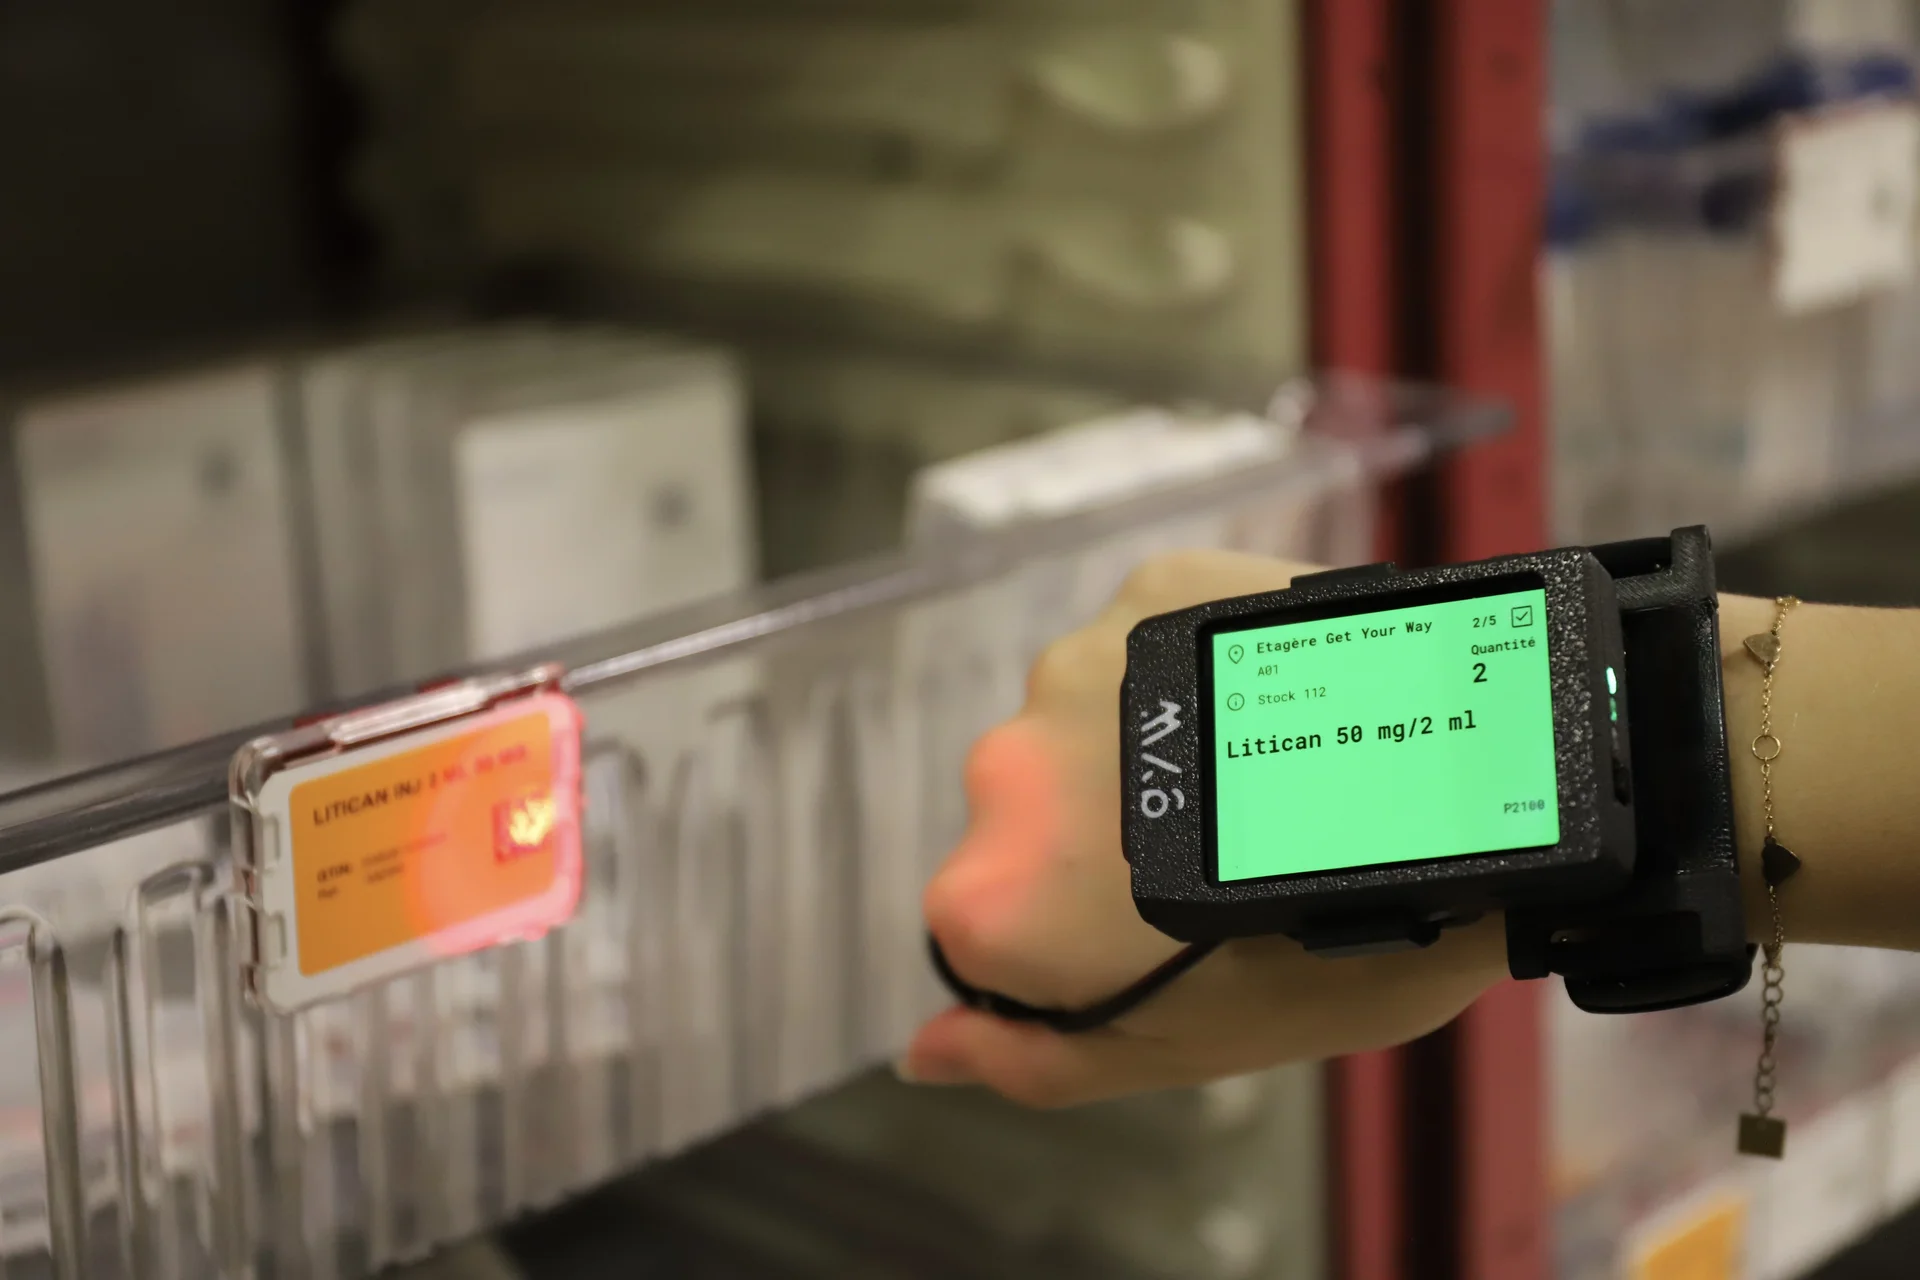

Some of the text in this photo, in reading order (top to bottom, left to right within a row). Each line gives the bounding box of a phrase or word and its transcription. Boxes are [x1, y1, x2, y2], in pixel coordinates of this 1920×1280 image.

[1472, 615, 1497, 628] 2/5
[1256, 621, 1433, 654] Etagère Get Your Way
[1471, 636, 1536, 656] Quantité
[1257, 664, 1279, 676] A01
[1472, 662, 1488, 683] 2
[1258, 686, 1327, 705] Stock 112
[1227, 709, 1477, 758] Litican 50 mg/2 ml
[312, 787, 389, 827] LITICAN
